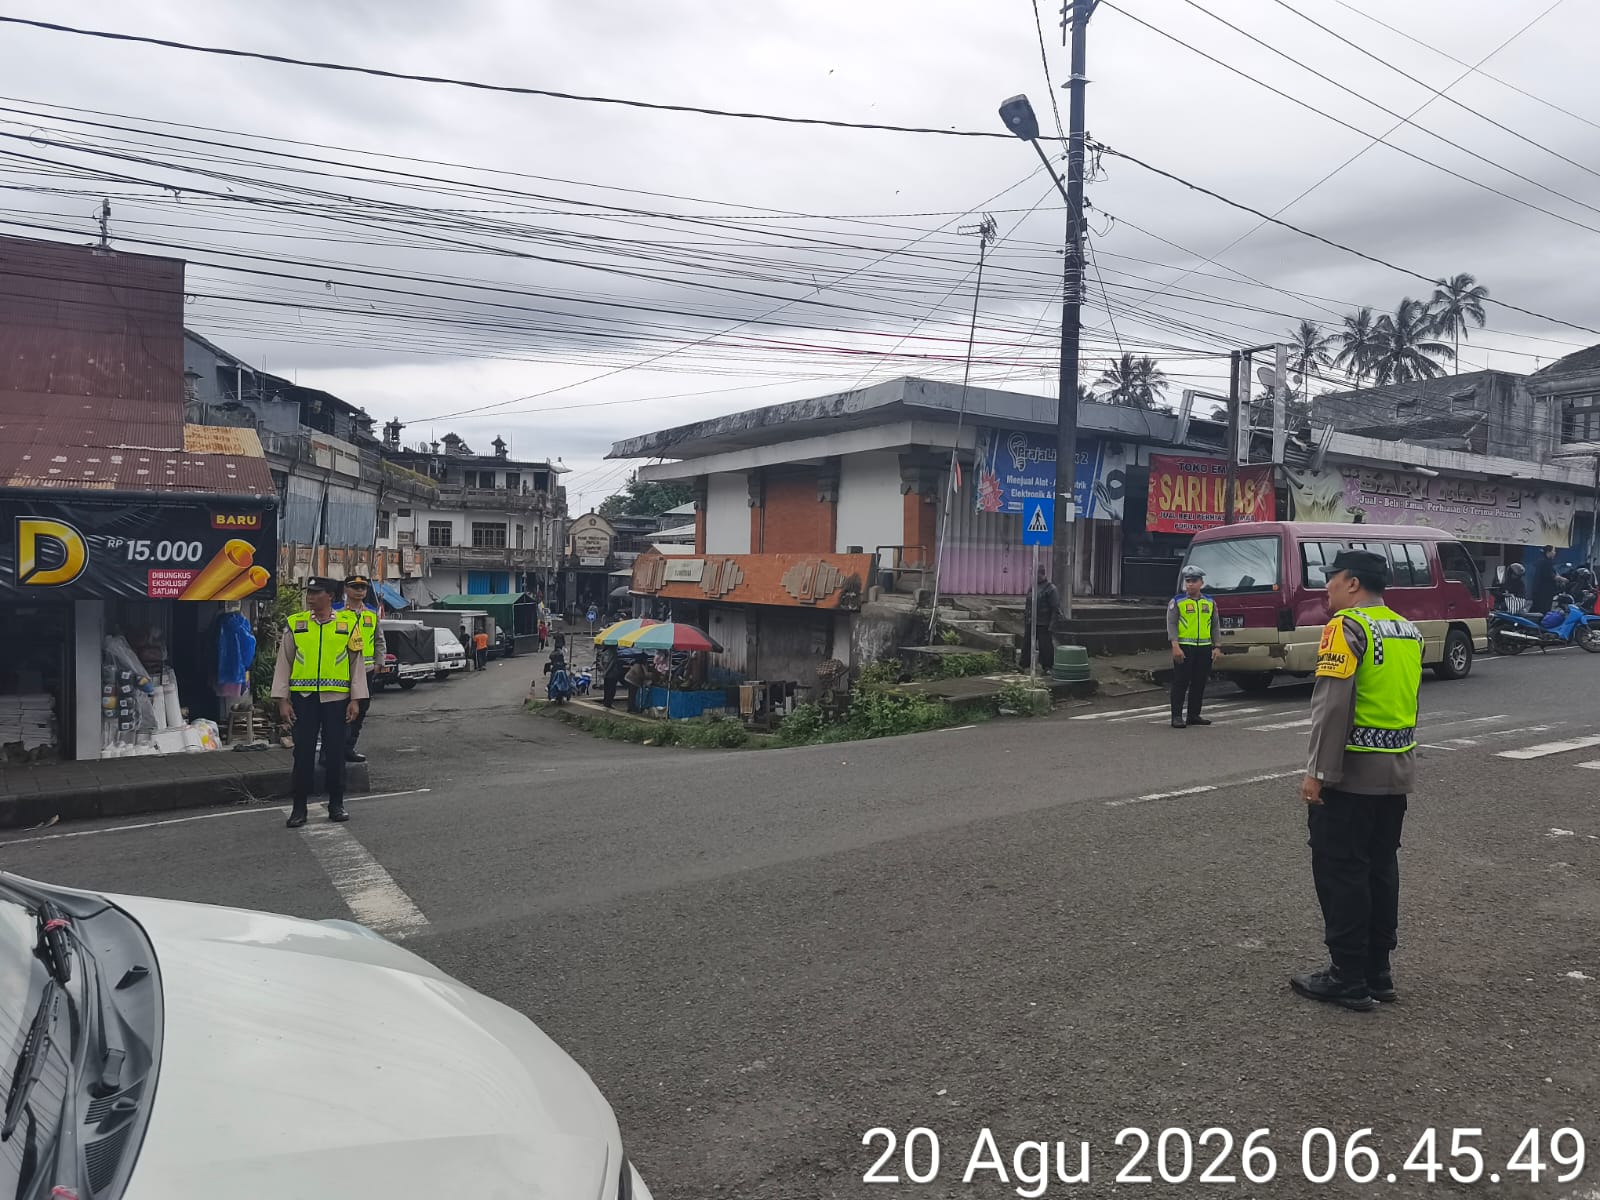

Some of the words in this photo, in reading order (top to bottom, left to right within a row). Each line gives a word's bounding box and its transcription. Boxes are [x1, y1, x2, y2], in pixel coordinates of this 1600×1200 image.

[1080, 452, 1089, 464] 2
[1178, 463, 1208, 474] TOKO
[1006, 475, 1034, 487] Menjual
[1035, 476, 1049, 486] Alat
[1360, 471, 1431, 501] SARI
[1011, 489, 1045, 499] Elektronik
[1159, 474, 1207, 512] SARI
[1360, 495, 1376, 505] Jual
[1427, 503, 1461, 514] Perhiasan
[1470, 506, 1493, 516] Terima
[1494, 508, 1521, 519] Pesanan
[216, 515, 257, 526] BARU
[1160, 511, 1176, 519] JUAL
[1178, 512, 1195, 521] BELI
[16, 516, 89, 588] D
[107, 540, 123, 548] RP
[127, 540, 203, 562] 15.000
[151, 571, 192, 579] DIBUNGKUS
[151, 587, 179, 595] SATUAN
